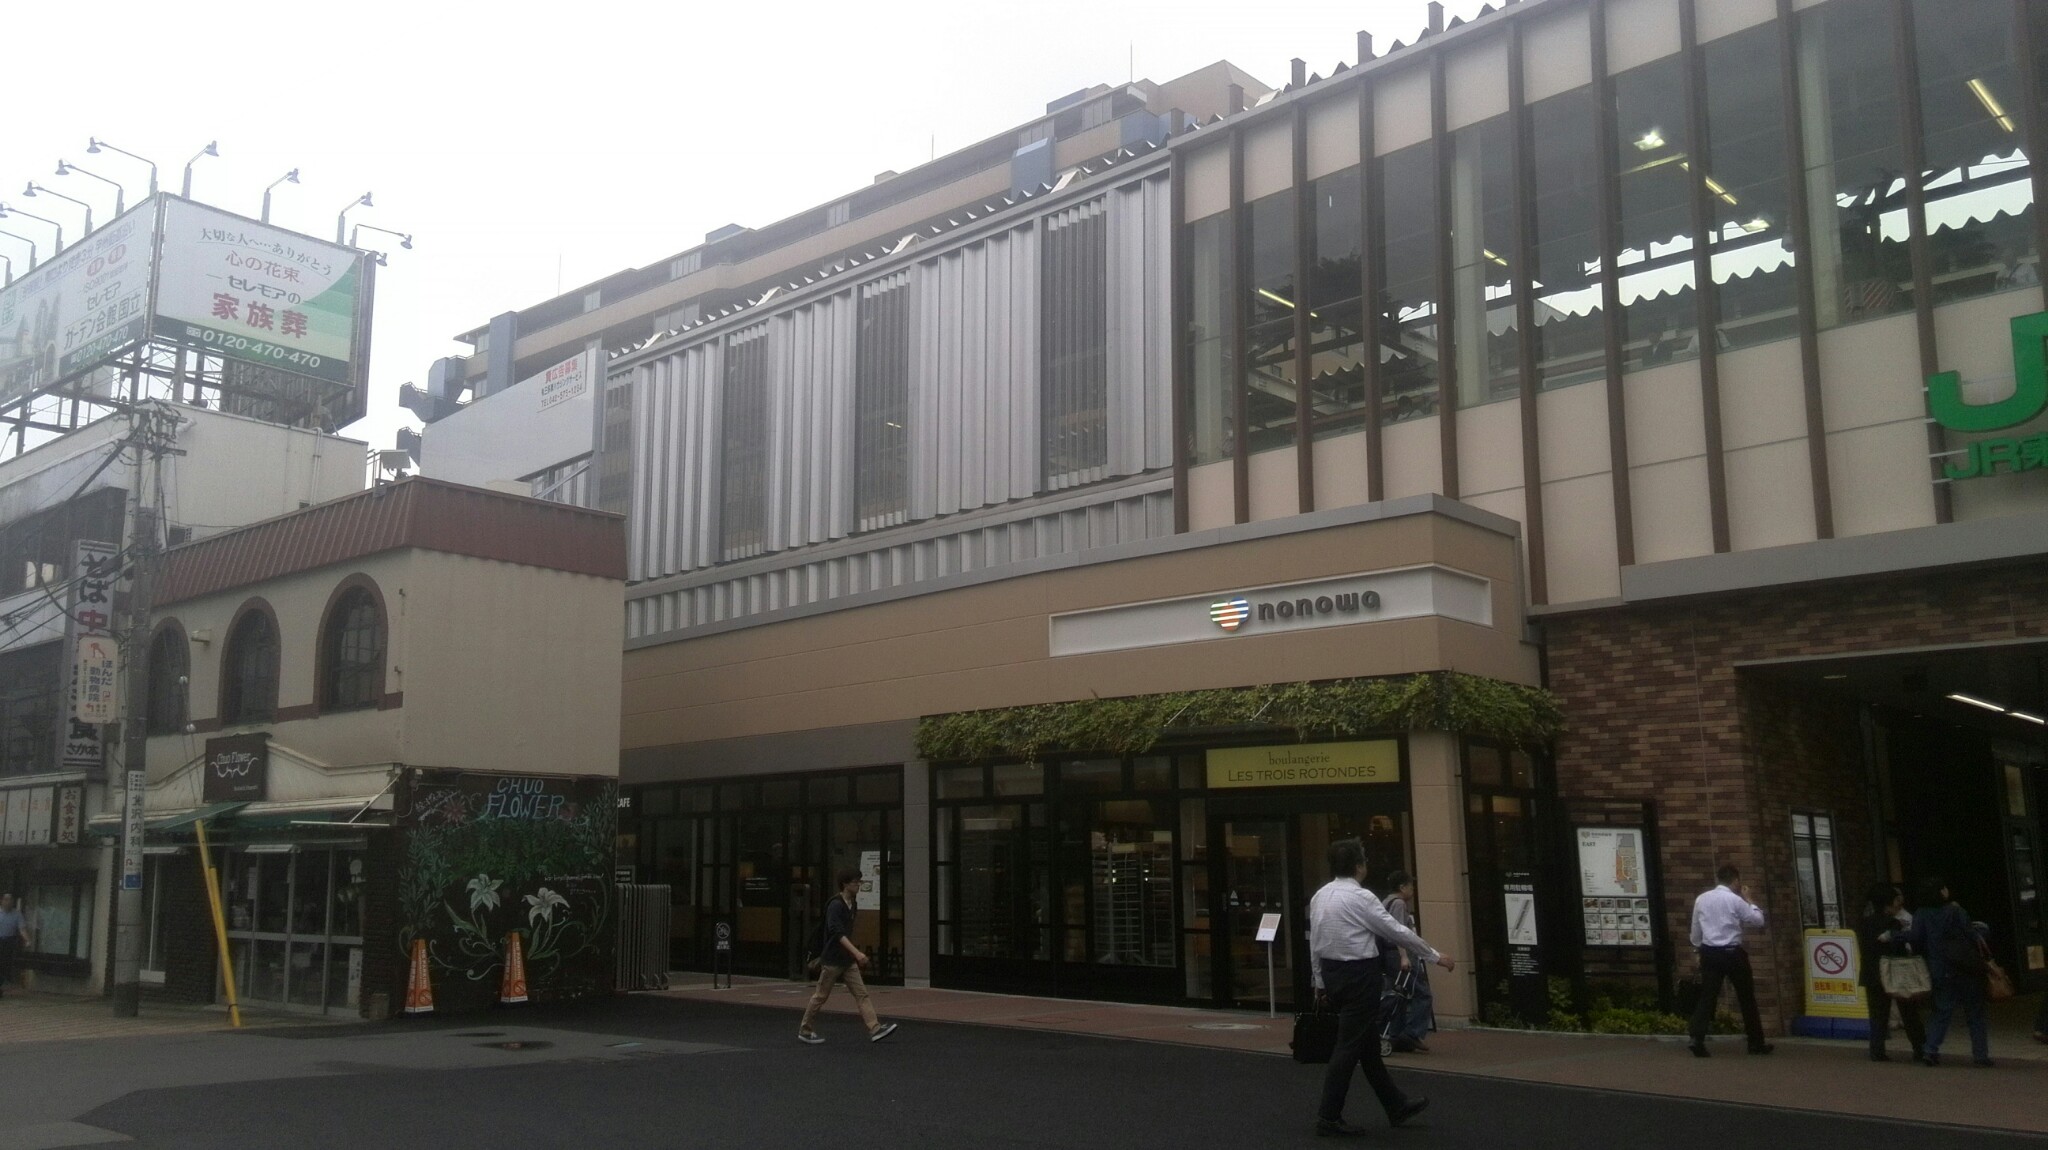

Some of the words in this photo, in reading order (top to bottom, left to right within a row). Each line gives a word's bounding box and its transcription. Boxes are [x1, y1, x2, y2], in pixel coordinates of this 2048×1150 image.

[200, 227, 332, 277] 大切な人へ…ありがとう
[225, 250, 300, 283] 心の花束
[86, 281, 122, 312] セレモア
[227, 274, 301, 305] セレモアの
[64, 292, 142, 350] ガーデン会館国立
[212, 293, 309, 339] 家族葬
[202, 329, 321, 368] 0120-470-470
[1257, 590, 1381, 621] nonowa
[1228, 769, 1253, 782] LES
[1256, 768, 1295, 781] TROIS
[1300, 766, 1376, 780] ROTONDES
[1268, 751, 1330, 767] boulangerie
[496, 778, 544, 795] CHUO
[62, 788, 77, 843] お食事処
[484, 794, 566, 820] FLOWER
